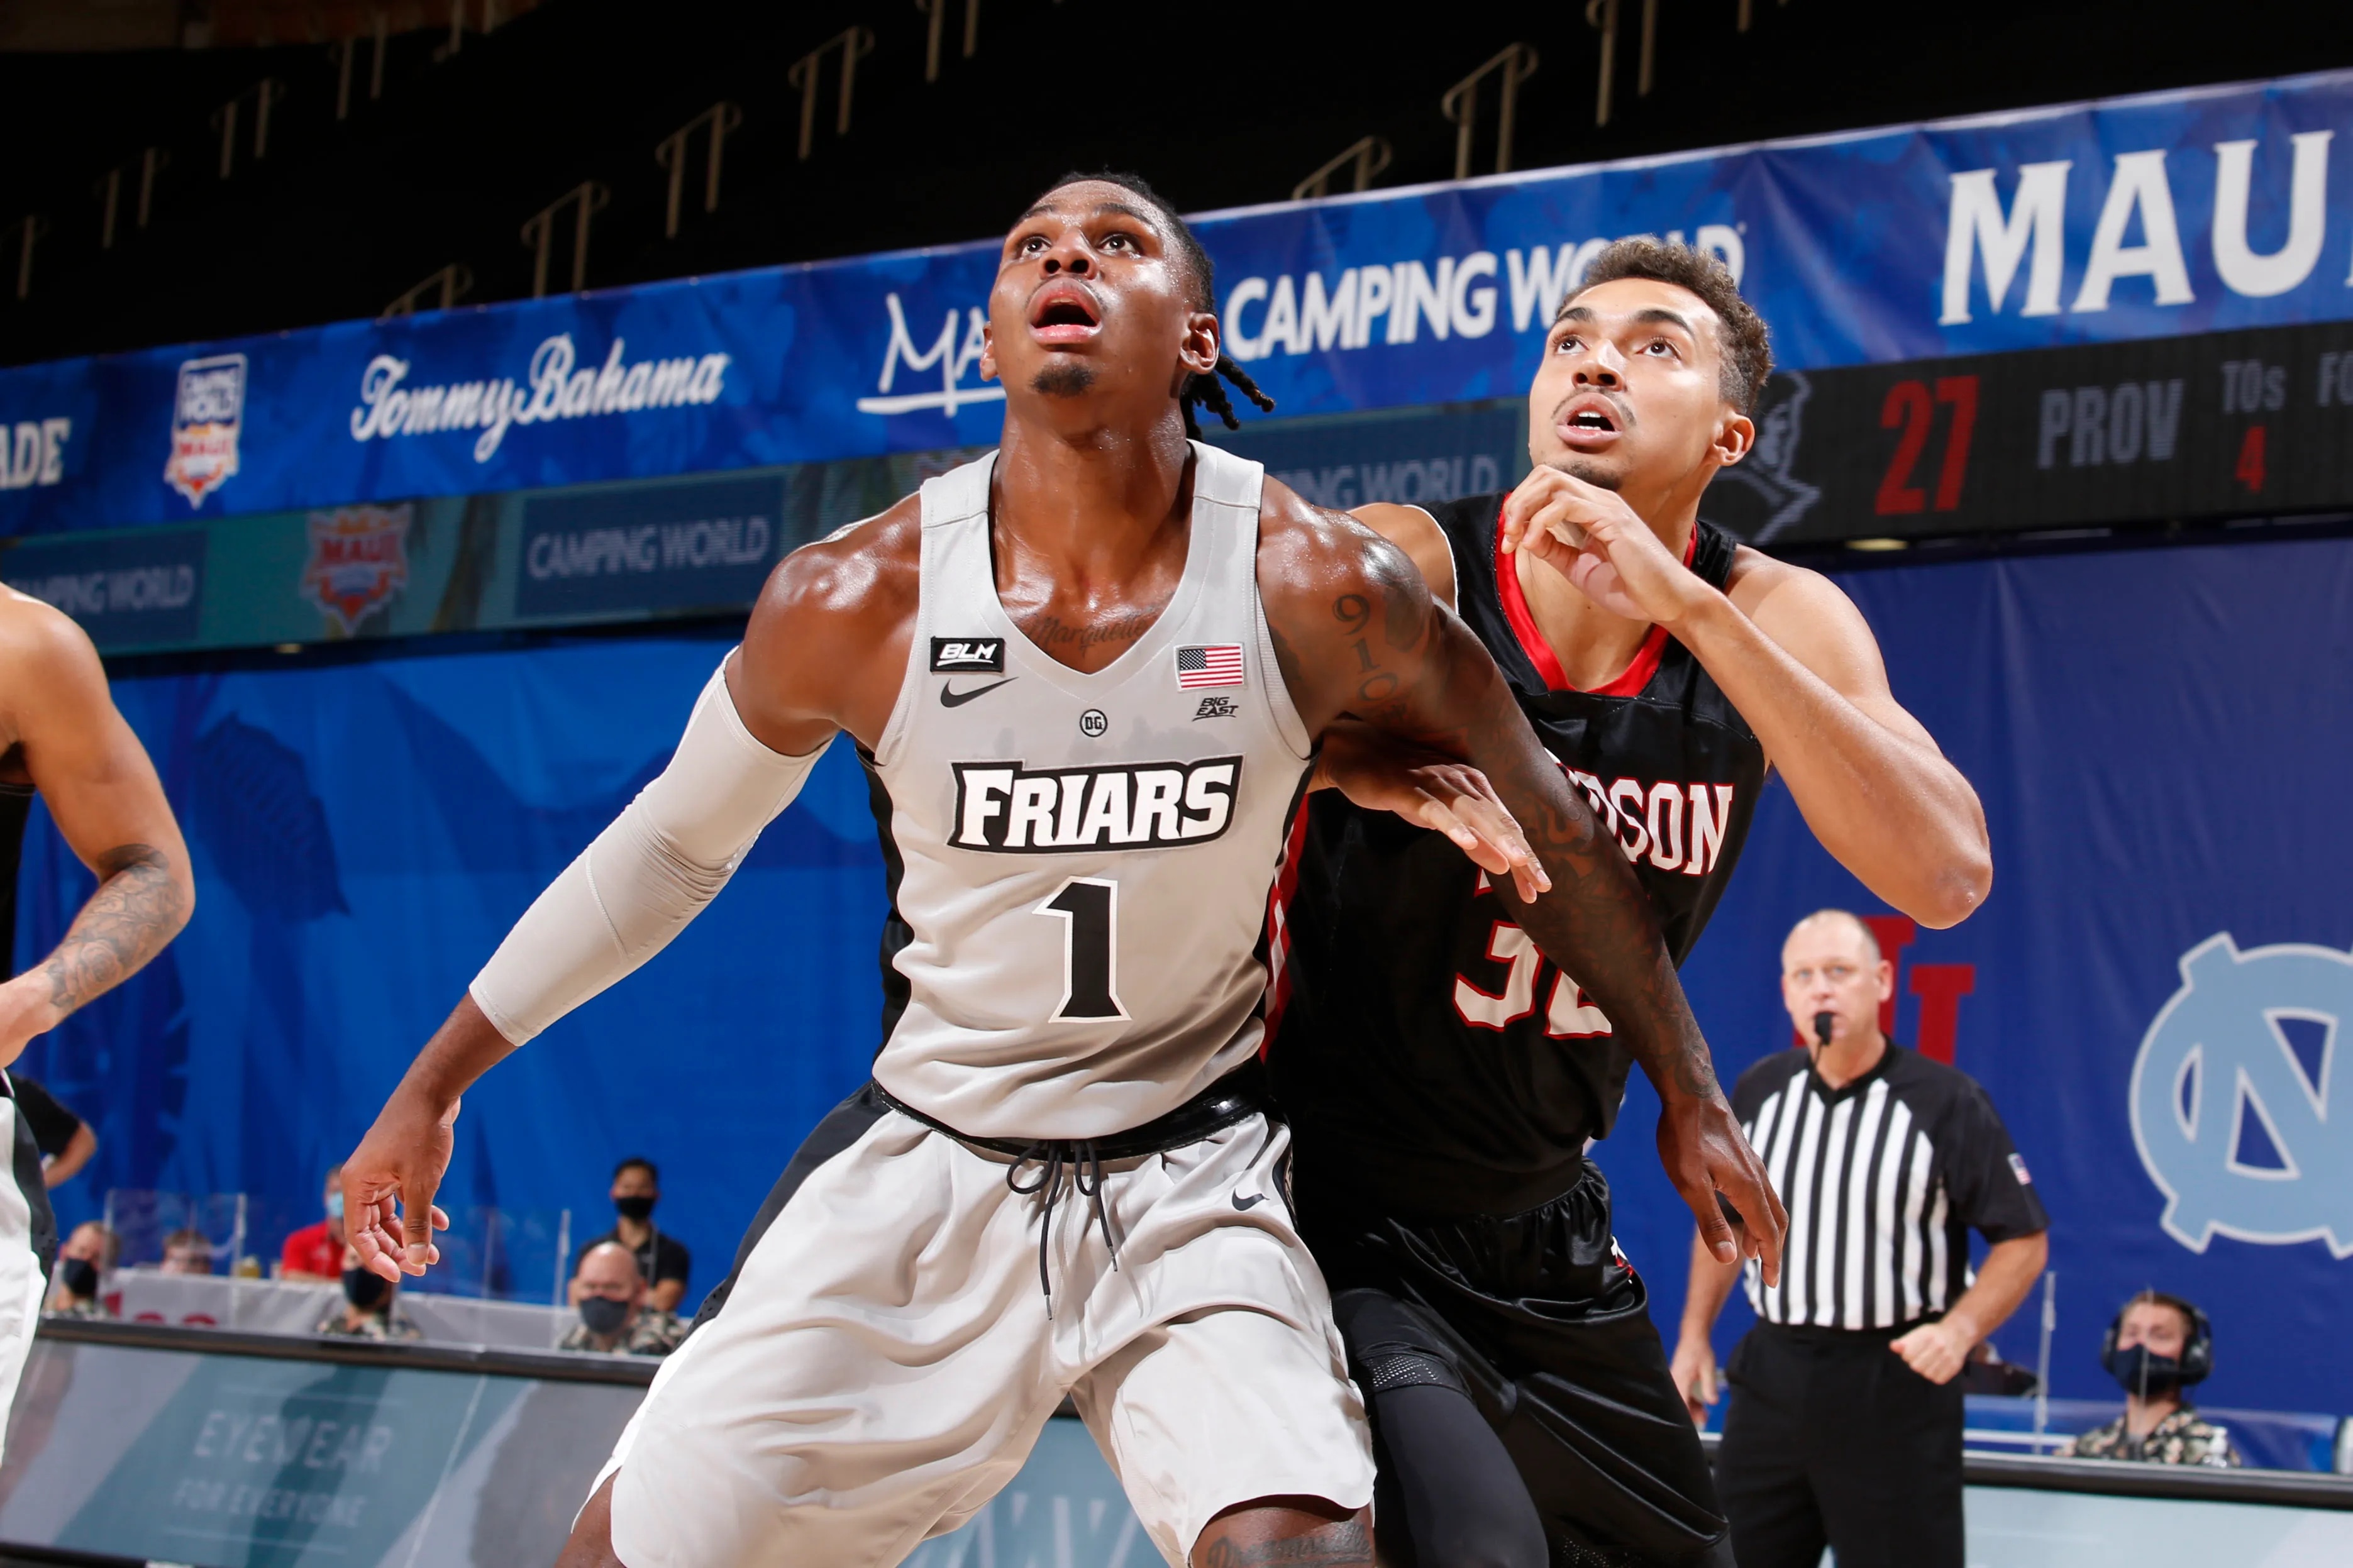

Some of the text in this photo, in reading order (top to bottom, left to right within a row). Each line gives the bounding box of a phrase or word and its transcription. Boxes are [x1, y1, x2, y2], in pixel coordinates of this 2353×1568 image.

[1939, 130, 2353, 325] MAU
[1224, 224, 1744, 362] CAMPING WOD
[352, 333, 729, 463] Tommy Bahama
[878, 292, 995, 417] MA
[1875, 376, 1979, 516] 27
[2037, 379, 2183, 470] PROV
[2235, 425, 2267, 494] 4
[1360, 454, 1500, 505] WORLD
[527, 517, 771, 578] CAMPING WORLD
[939, 643, 997, 660] BLM
[1085, 715, 1102, 730] DG
[1196, 705, 1239, 716] EAST
[1200, 696, 1230, 707] BIG
[958, 762, 1236, 848] FRIARS
[1568, 766, 1734, 877] DSON
[1032, 875, 1132, 1024] 1
